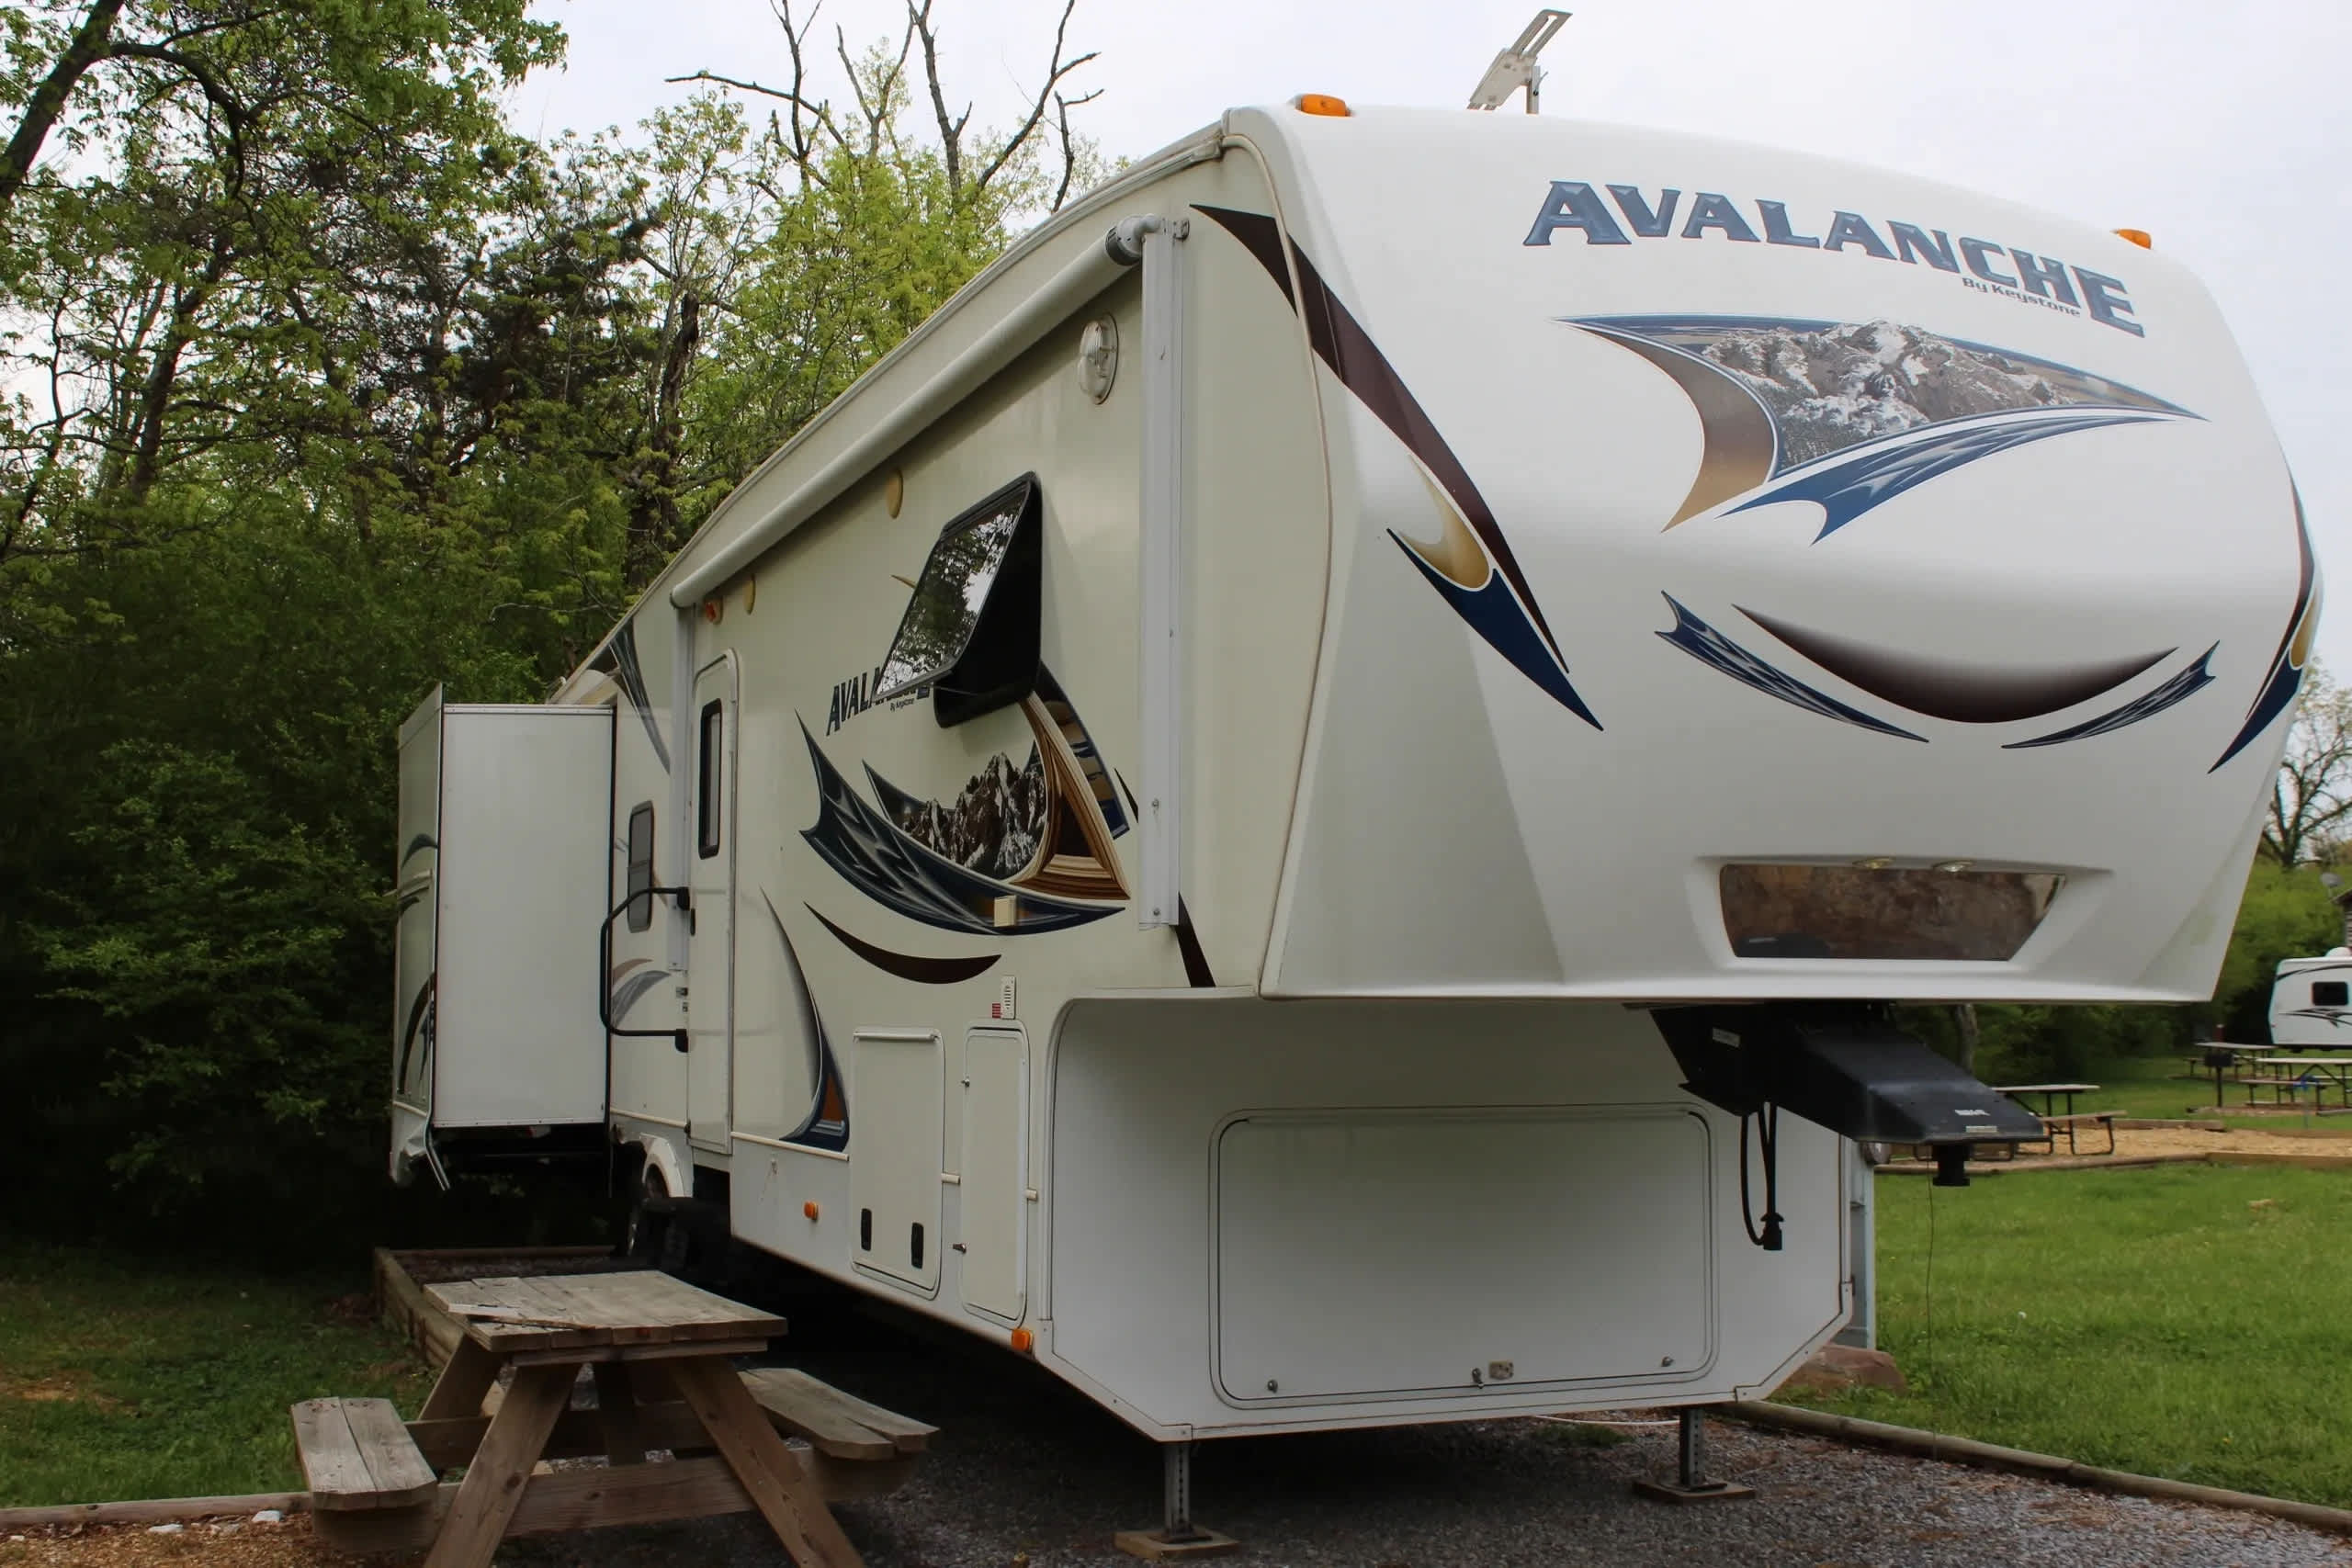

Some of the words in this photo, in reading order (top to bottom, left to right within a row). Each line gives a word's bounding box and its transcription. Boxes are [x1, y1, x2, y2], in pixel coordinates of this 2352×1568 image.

[1522, 180, 2145, 338] AVALANCHE
[1962, 277, 1987, 293] By
[1993, 284, 2081, 318] Keystone
